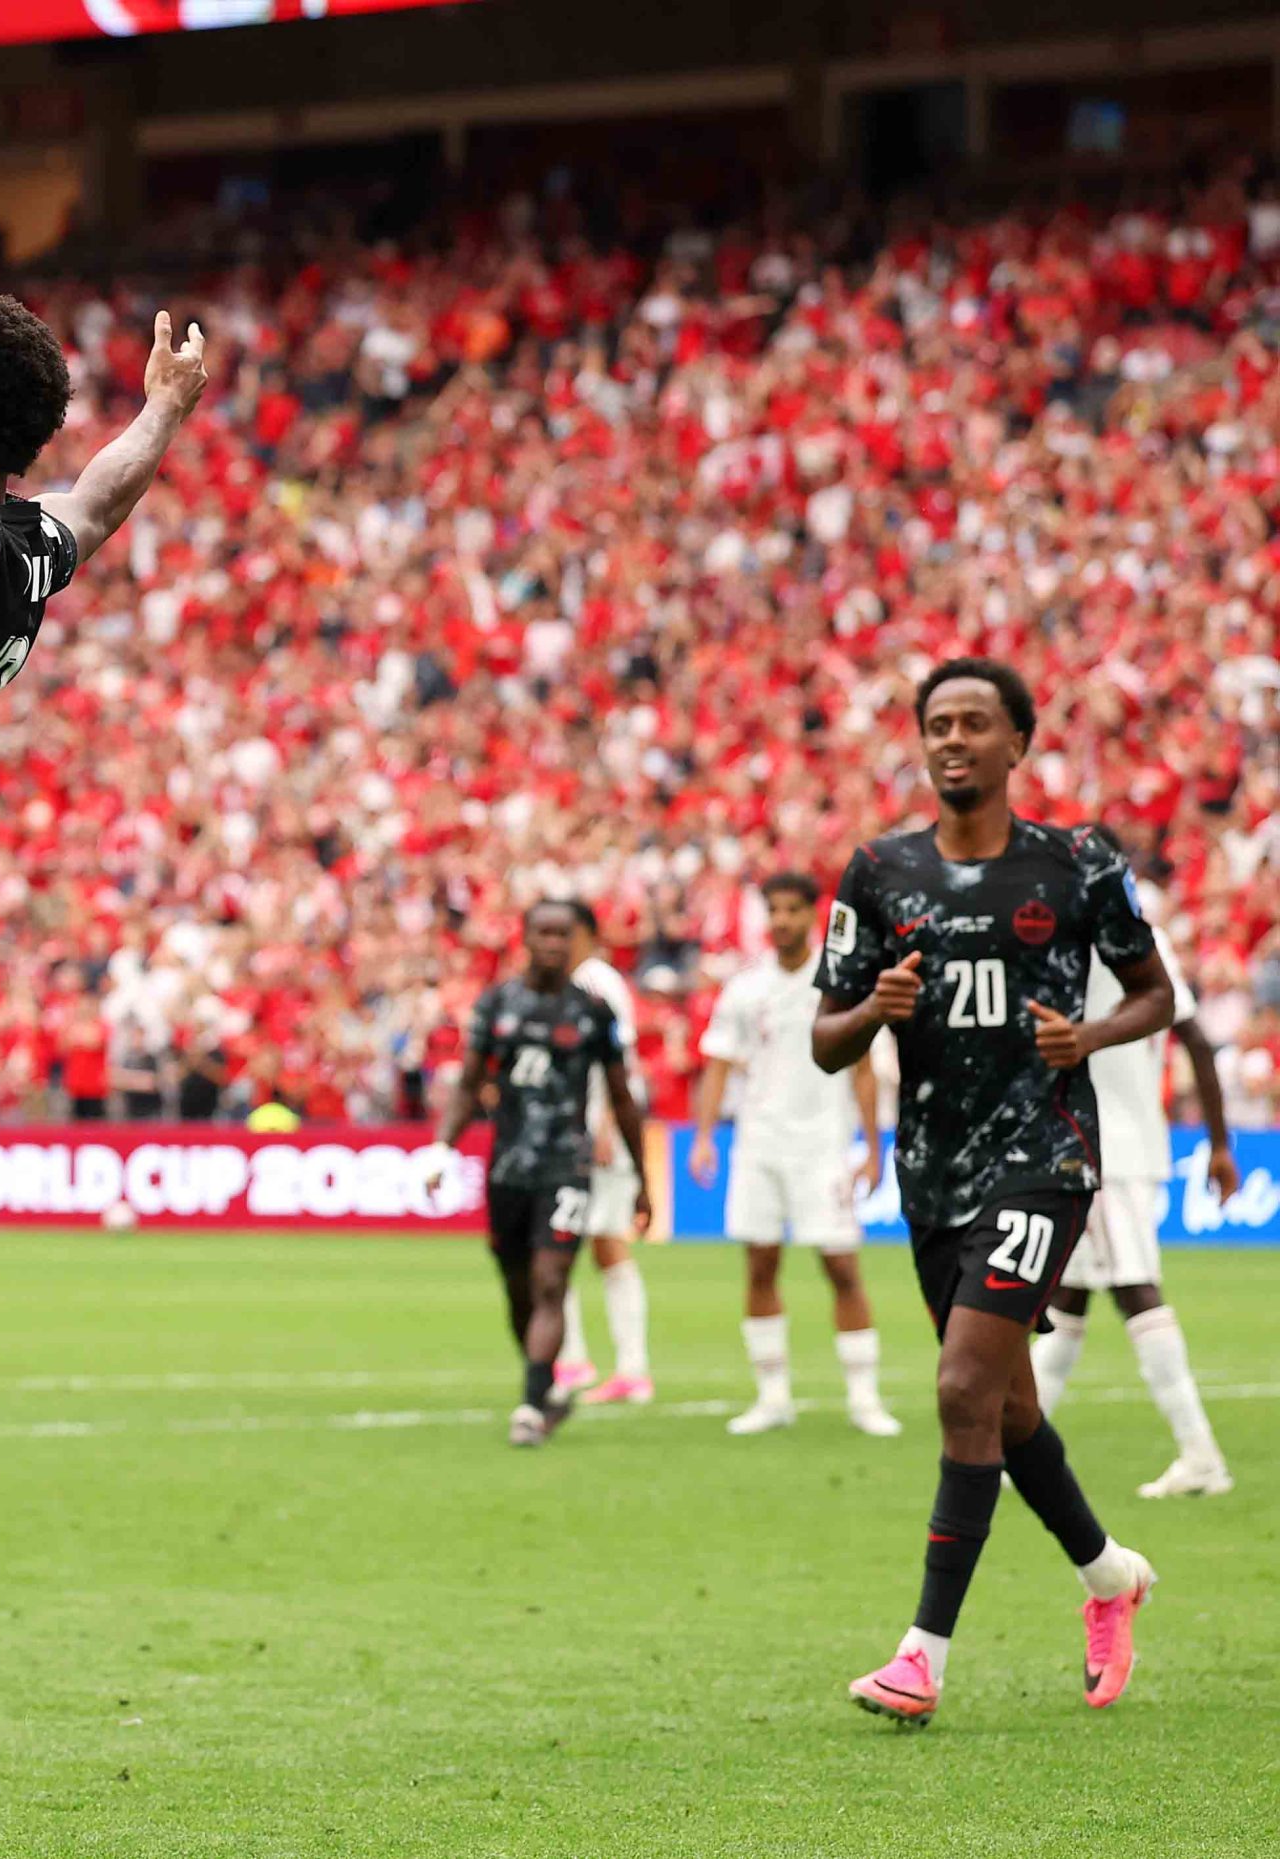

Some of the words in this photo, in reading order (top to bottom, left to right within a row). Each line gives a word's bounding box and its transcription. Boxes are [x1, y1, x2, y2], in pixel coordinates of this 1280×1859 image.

[944, 958, 1008, 1029] 20
[123, 1143, 247, 1213] CUP
[986, 1208, 1055, 1285] 20
